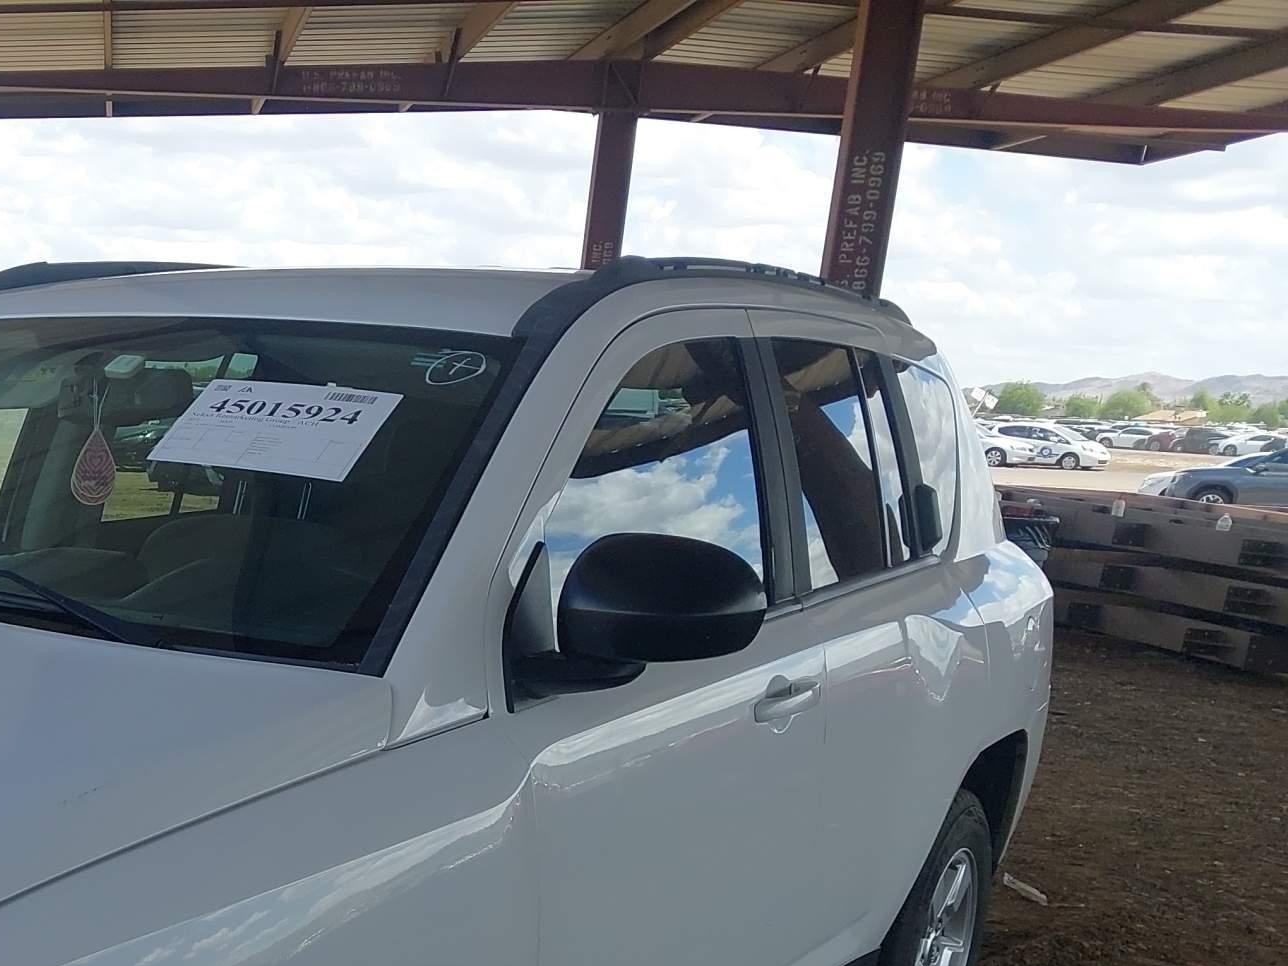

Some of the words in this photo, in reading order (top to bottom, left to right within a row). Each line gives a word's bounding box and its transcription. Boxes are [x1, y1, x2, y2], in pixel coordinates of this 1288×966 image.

[838, 194, 862, 263] PREFAB
[851, 149, 870, 184] INC.
[209, 398, 363, 425] 45015924
